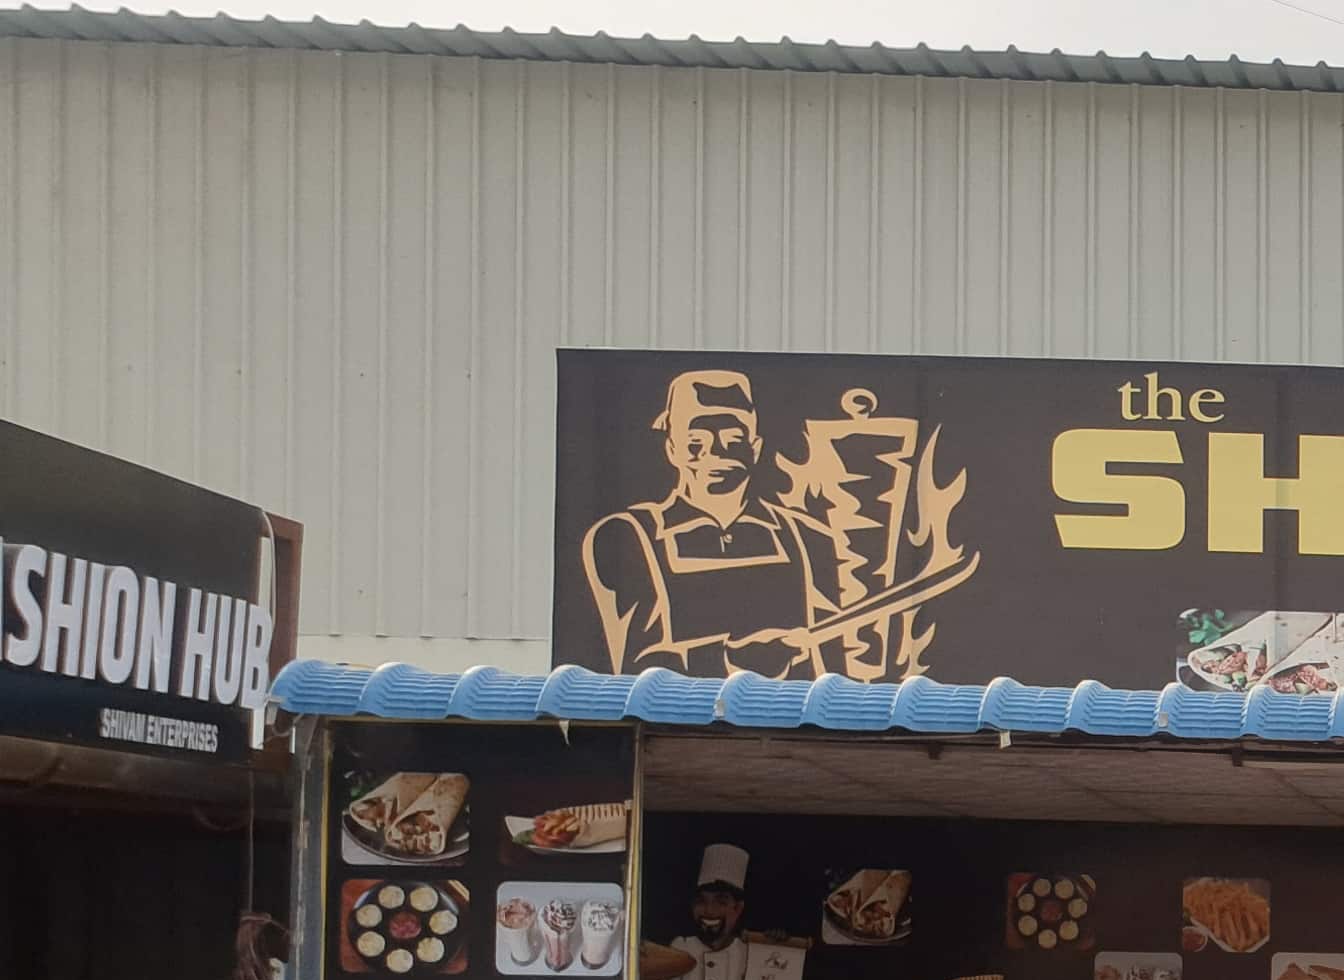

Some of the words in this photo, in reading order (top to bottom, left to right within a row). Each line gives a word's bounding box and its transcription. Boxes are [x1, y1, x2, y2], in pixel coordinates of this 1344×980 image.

[1117, 371, 1226, 423] the
[0, 537, 177, 694] SHION
[178, 588, 273, 710] HUB
[146, 715, 218, 752] ENTERPRISES
